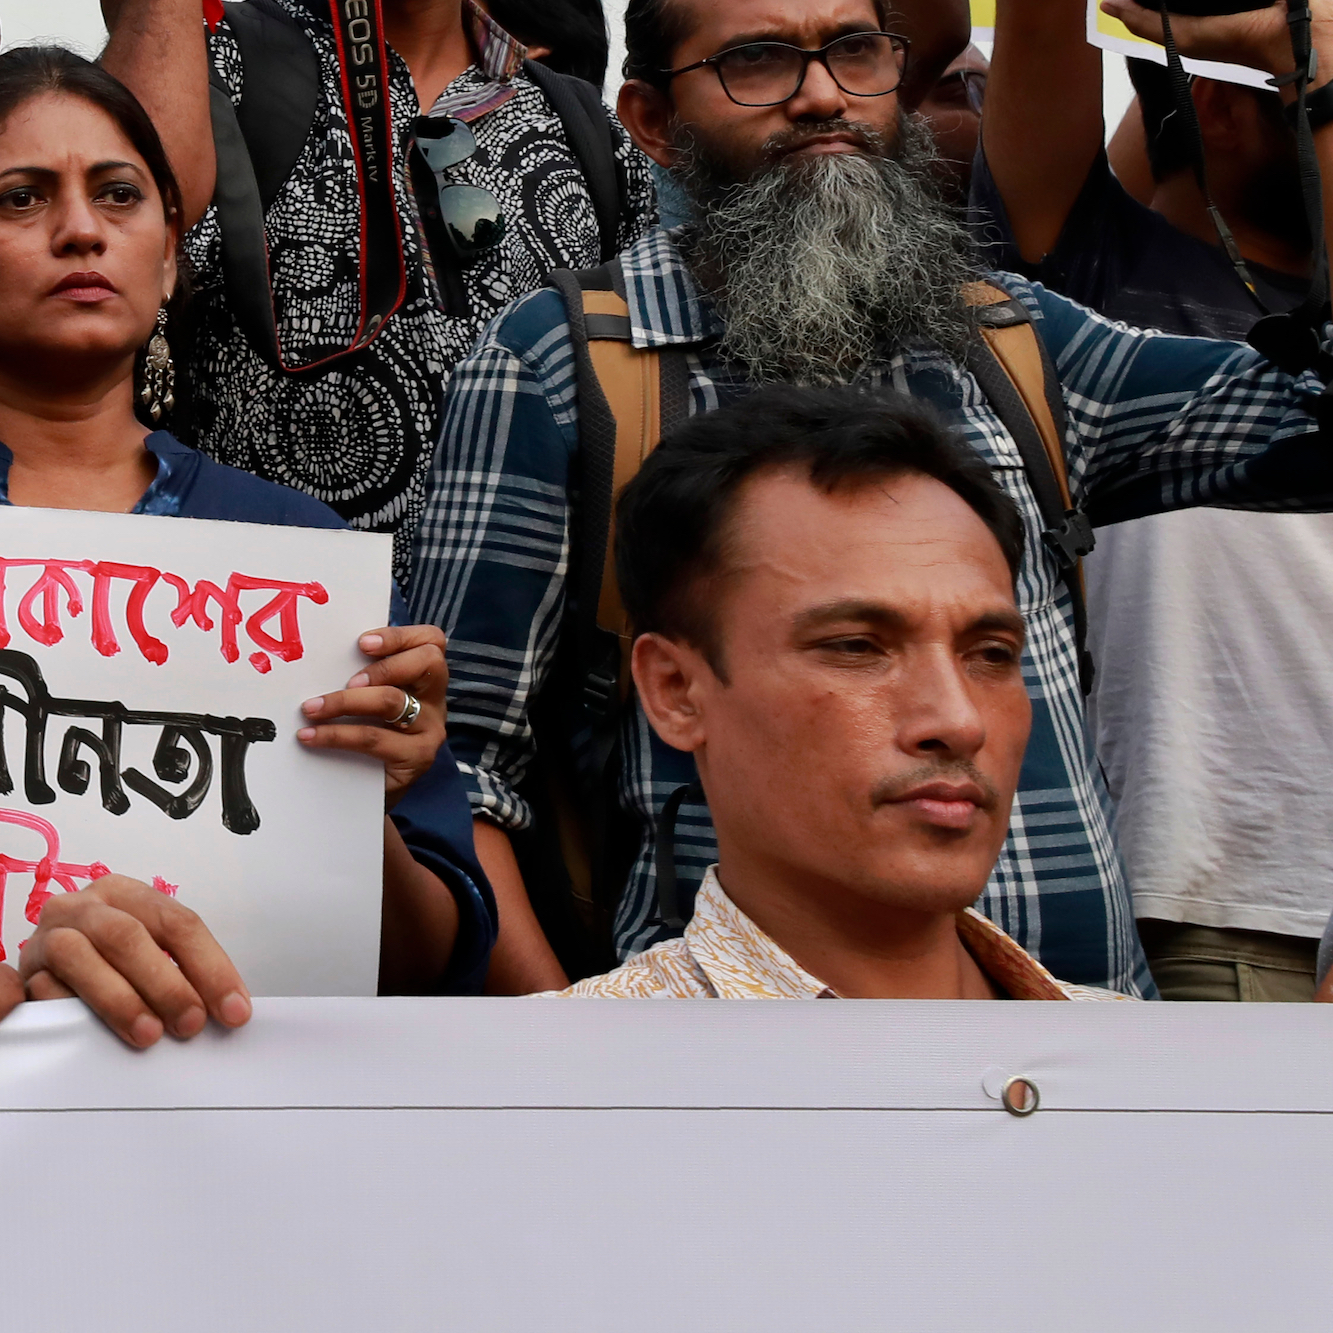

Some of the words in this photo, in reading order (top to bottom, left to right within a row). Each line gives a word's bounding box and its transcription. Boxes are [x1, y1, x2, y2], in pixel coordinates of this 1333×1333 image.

[356, 74, 378, 109] 5D
[361, 116, 377, 162] Mark
[368, 165, 378, 183] IV
